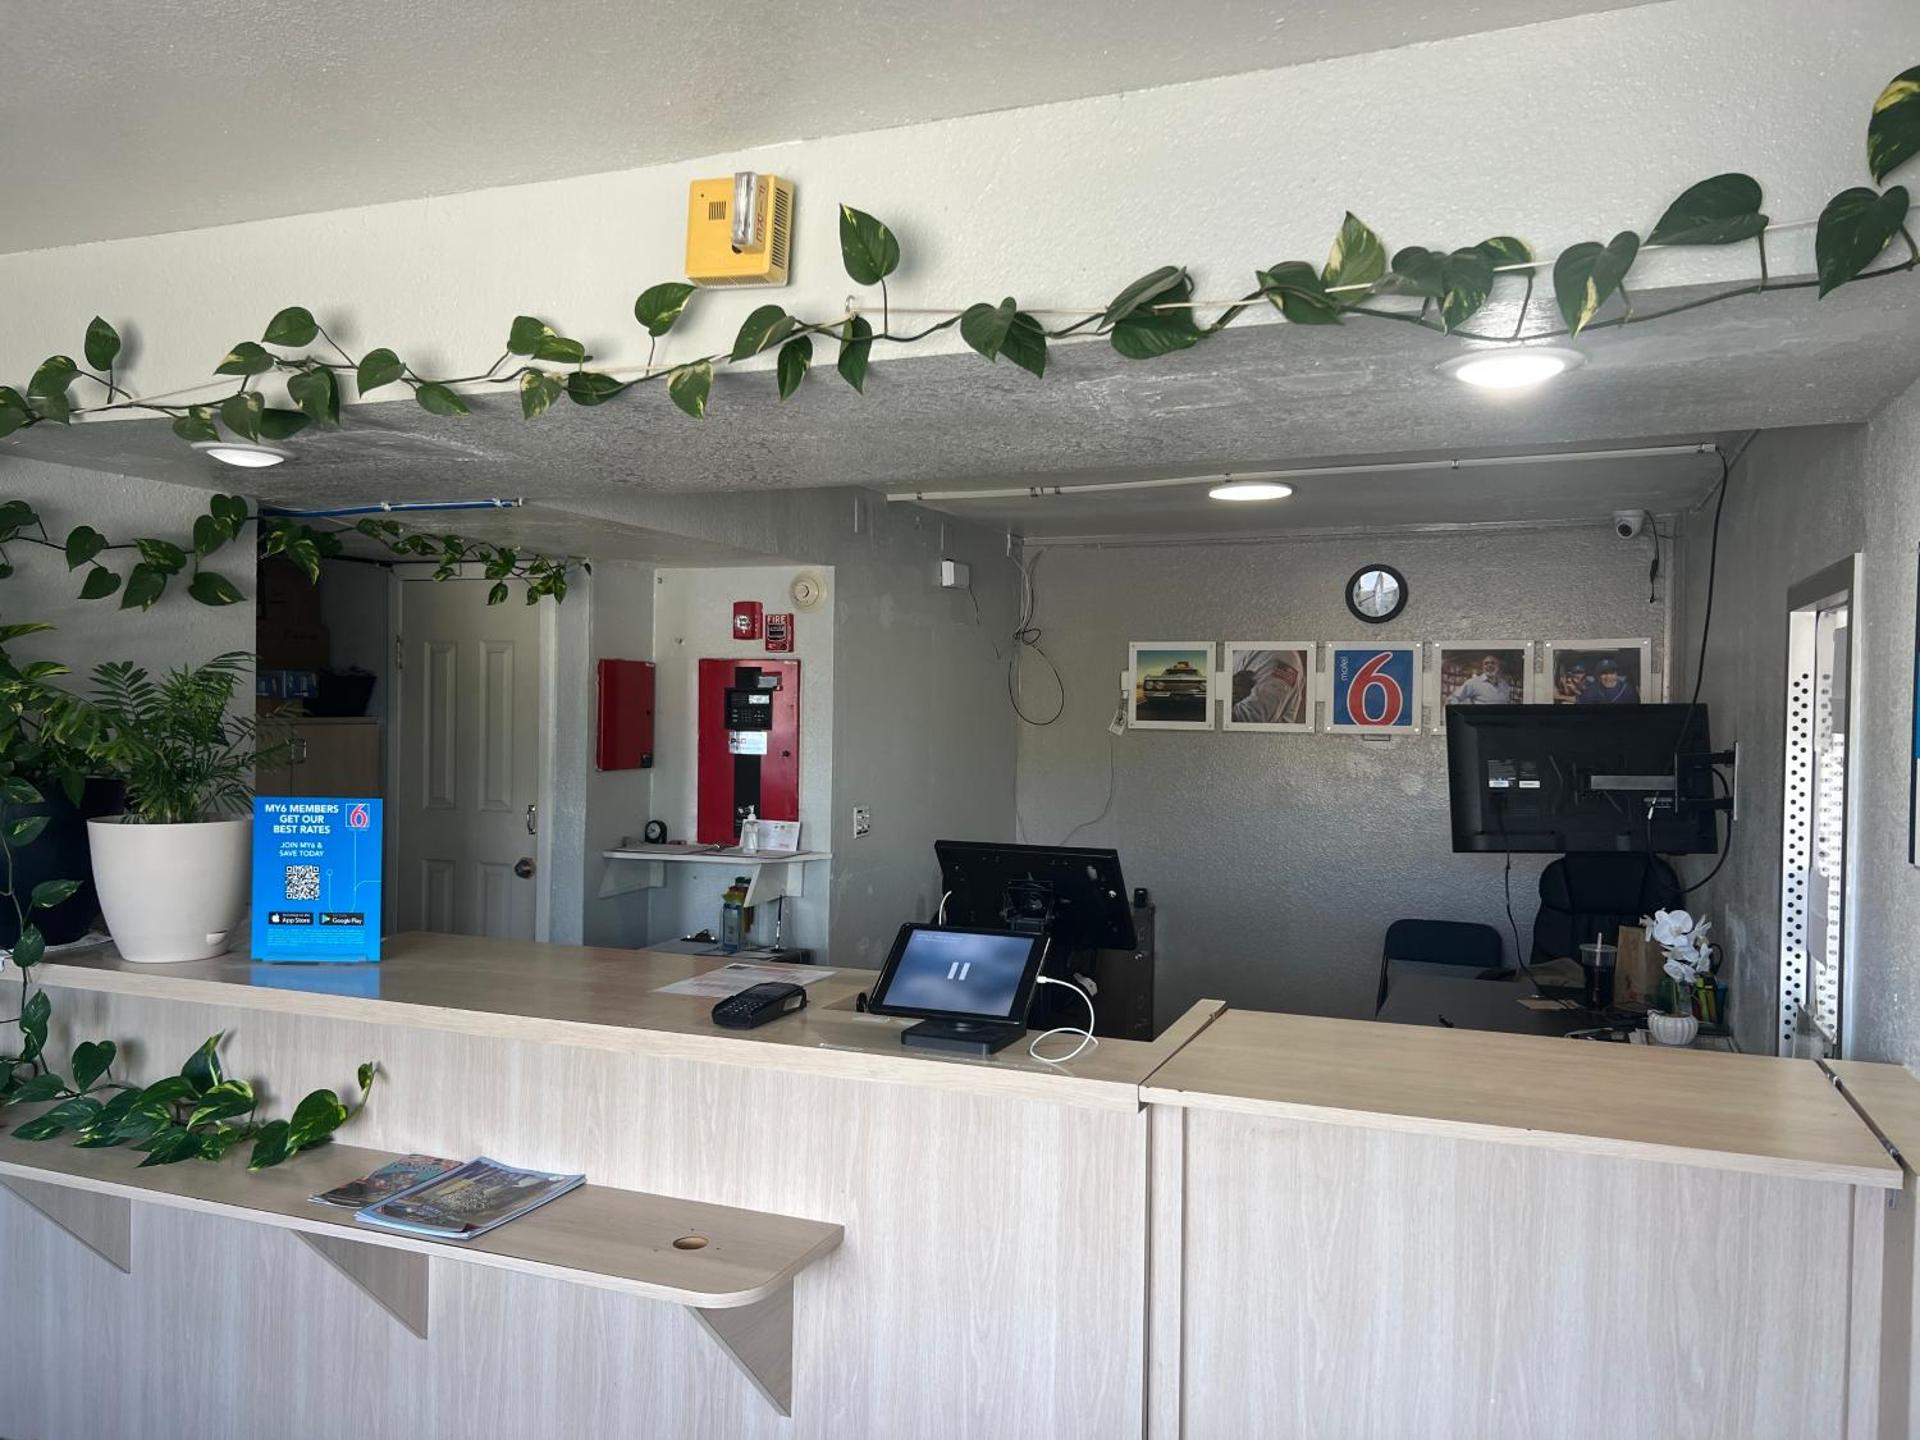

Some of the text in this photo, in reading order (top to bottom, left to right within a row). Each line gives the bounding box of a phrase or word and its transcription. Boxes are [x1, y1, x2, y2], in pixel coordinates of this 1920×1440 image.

[767, 615, 787, 624] FIRE
[1340, 656, 1348, 681] motel
[1347, 651, 1403, 727] 6
[265, 804, 339, 814] MY6 MEMBERS
[279, 815, 325, 824] GET OUR
[351, 803, 368, 828] 6
[273, 825, 331, 834] BEST RATES
